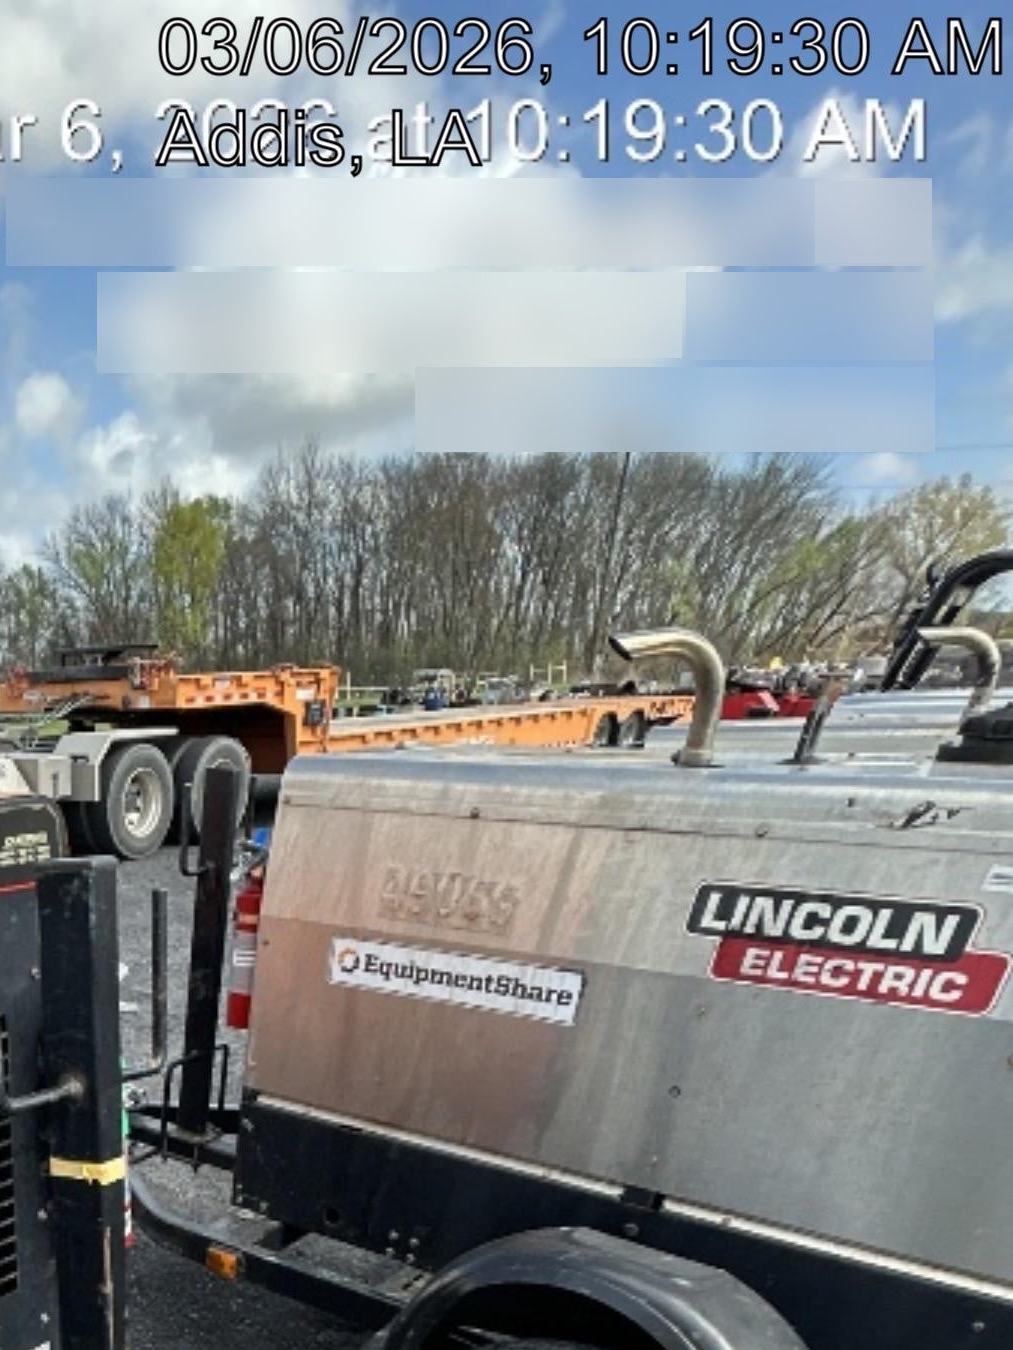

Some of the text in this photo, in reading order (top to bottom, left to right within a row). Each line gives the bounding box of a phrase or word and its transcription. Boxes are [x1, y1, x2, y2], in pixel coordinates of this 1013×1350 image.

[699, 893, 961, 955] LINCOLN
[363, 953, 574, 1006] EquipmentShare
[740, 948, 970, 1001] ELECTRIC
